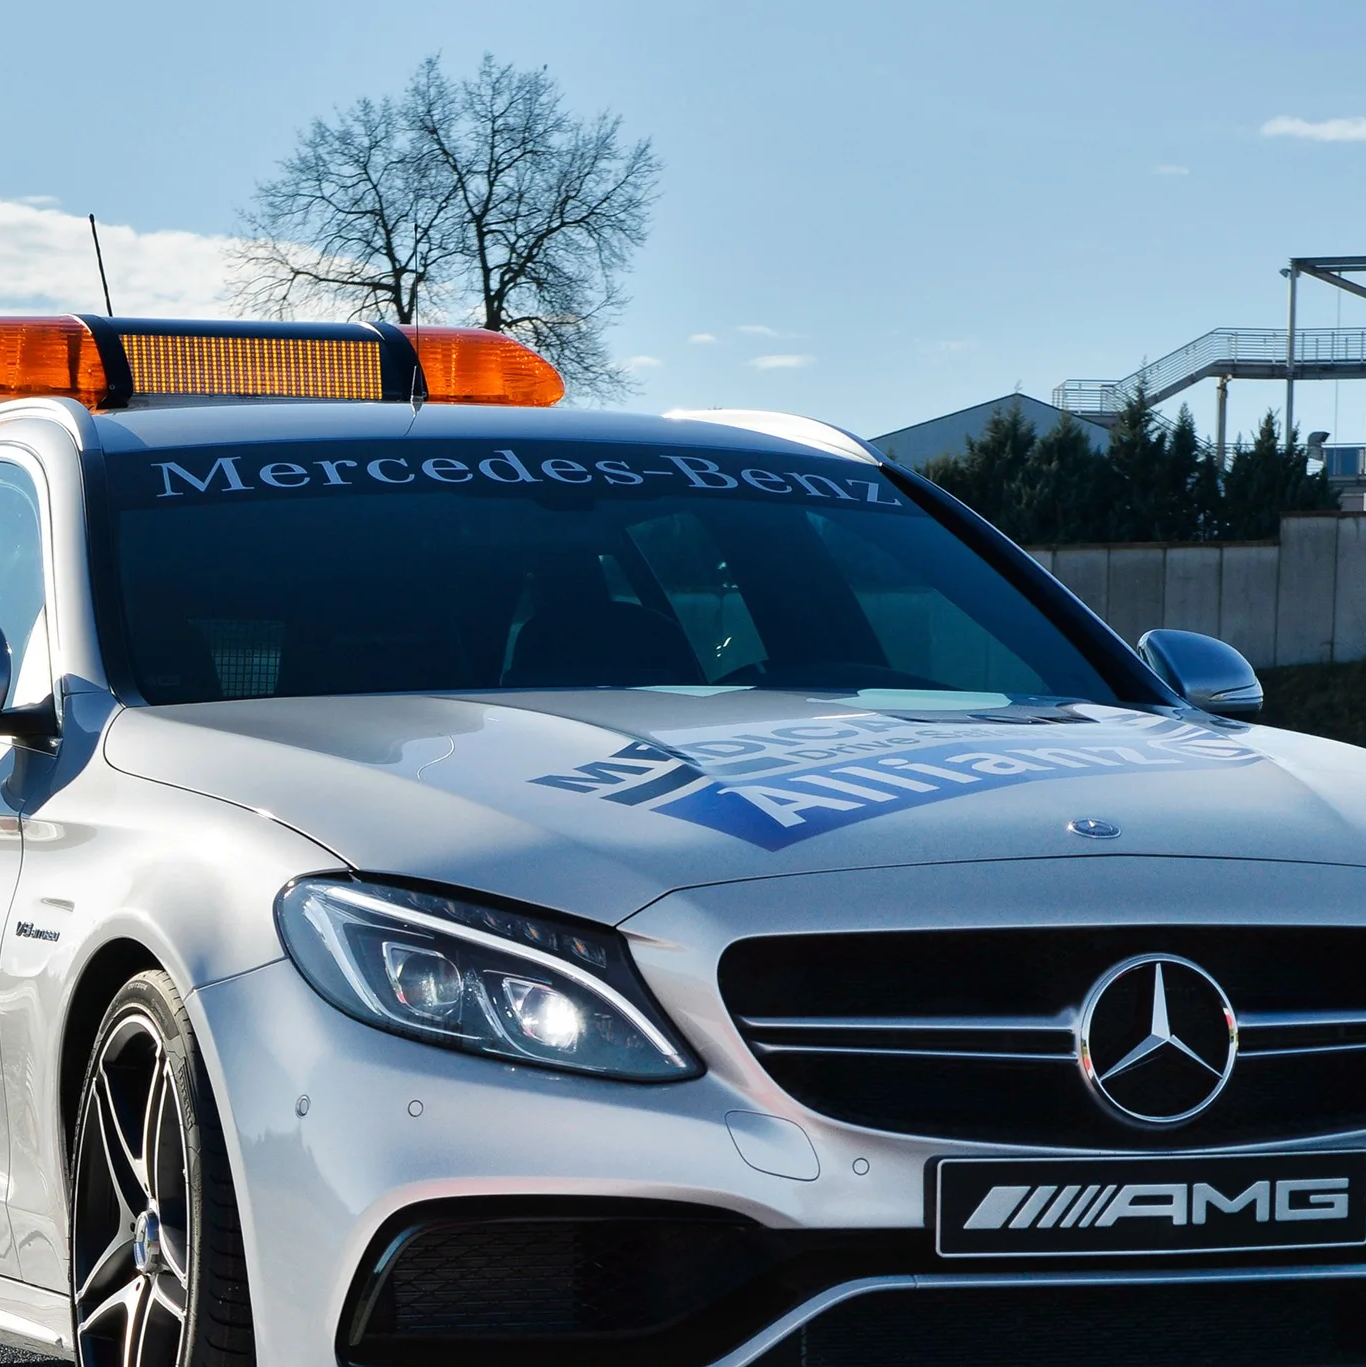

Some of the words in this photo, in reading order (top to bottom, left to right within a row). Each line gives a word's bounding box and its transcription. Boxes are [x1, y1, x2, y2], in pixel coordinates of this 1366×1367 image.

[154, 450, 903, 507] Mercedes-Benz
[784, 737, 921, 761] Drive
[718, 745, 1184, 828] Allianz
[1095, 1177, 1350, 1228] AMG
